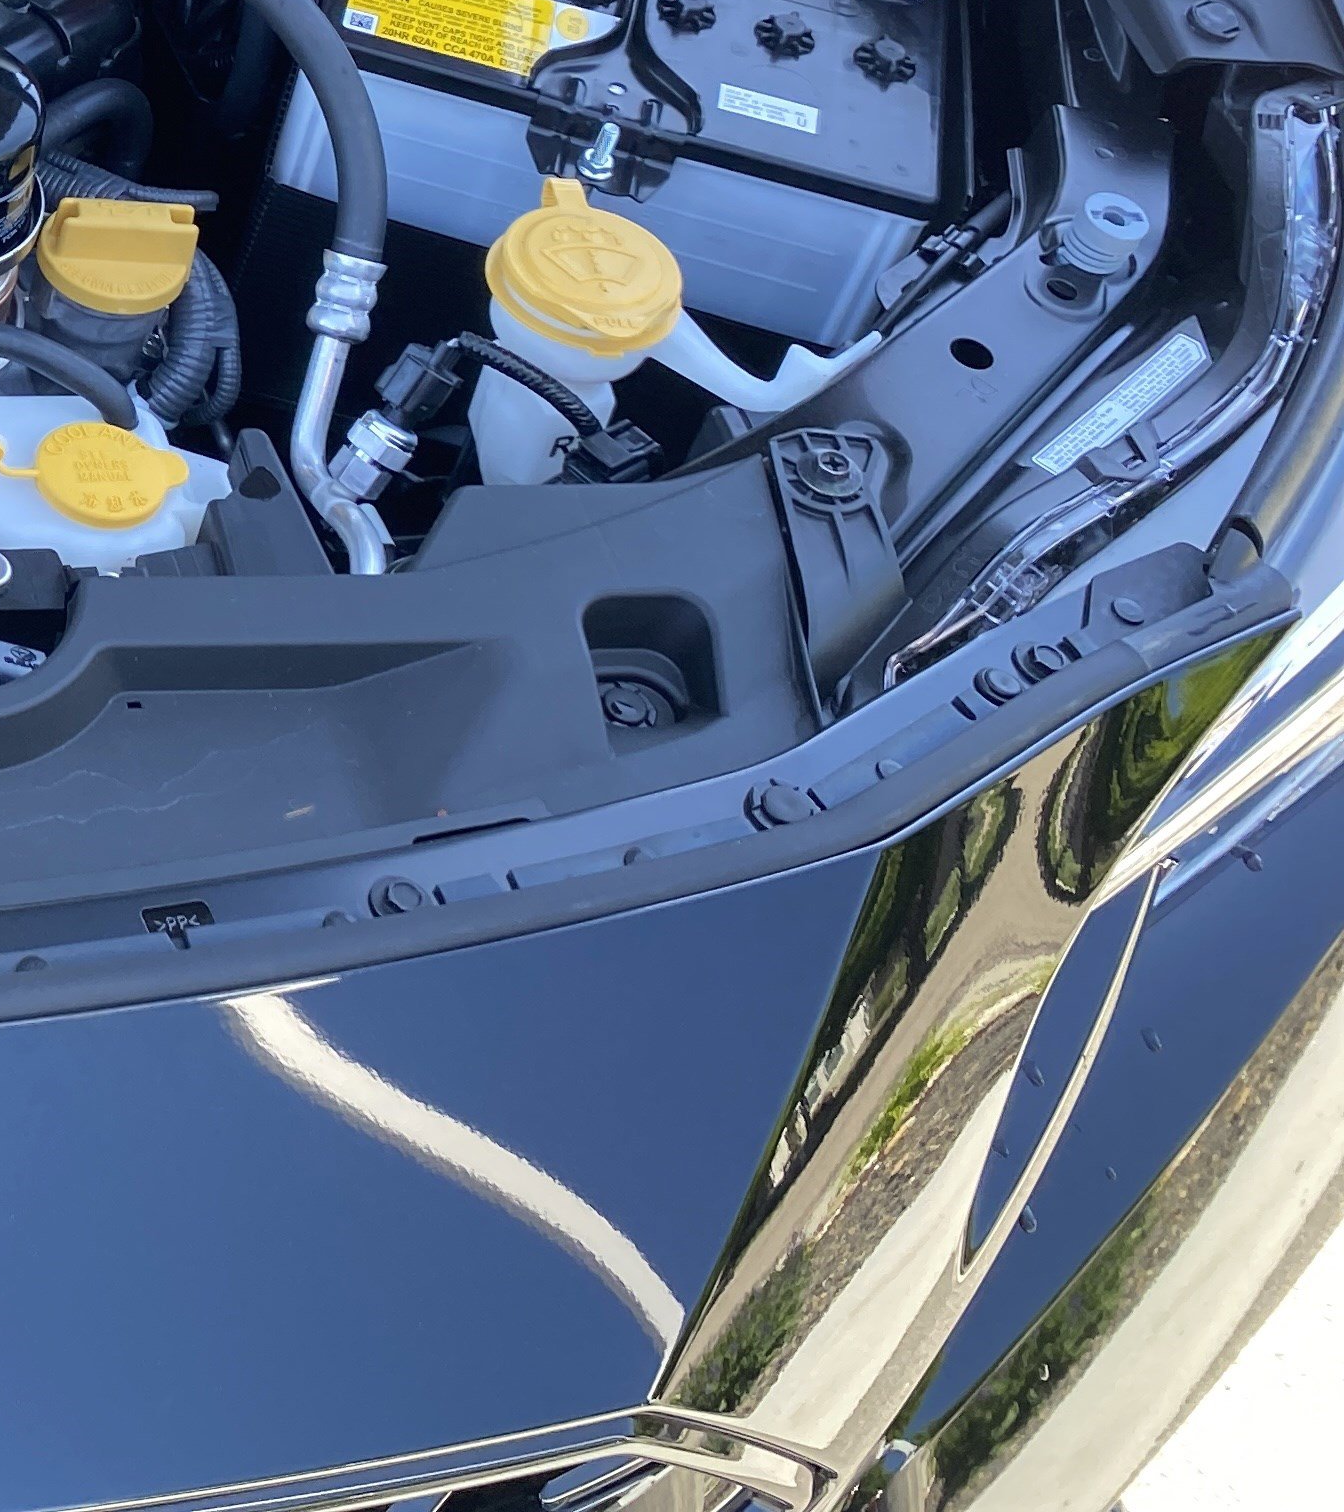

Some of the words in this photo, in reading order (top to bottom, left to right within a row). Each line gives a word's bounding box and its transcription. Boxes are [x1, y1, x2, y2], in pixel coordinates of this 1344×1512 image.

[392, 13, 416, 24] KEEP
[418, 19, 440, 30] VENT
[443, 26, 466, 38] CAPS
[418, 0, 454, 14] CAUSES
[456, 9, 491, 24] SEVERE
[382, 27, 409, 41] 20HR
[412, 34, 438, 48] 62Ah
[443, 43, 467, 56] CCA
[469, 50, 495, 64] 470A
[390, 20, 414, 32] KEEP
[416, 27, 435, 37] OUT
[436, 31, 449, 40] OF
[451, 36, 481, 49] REACH
[483, 44, 495, 53] OF
